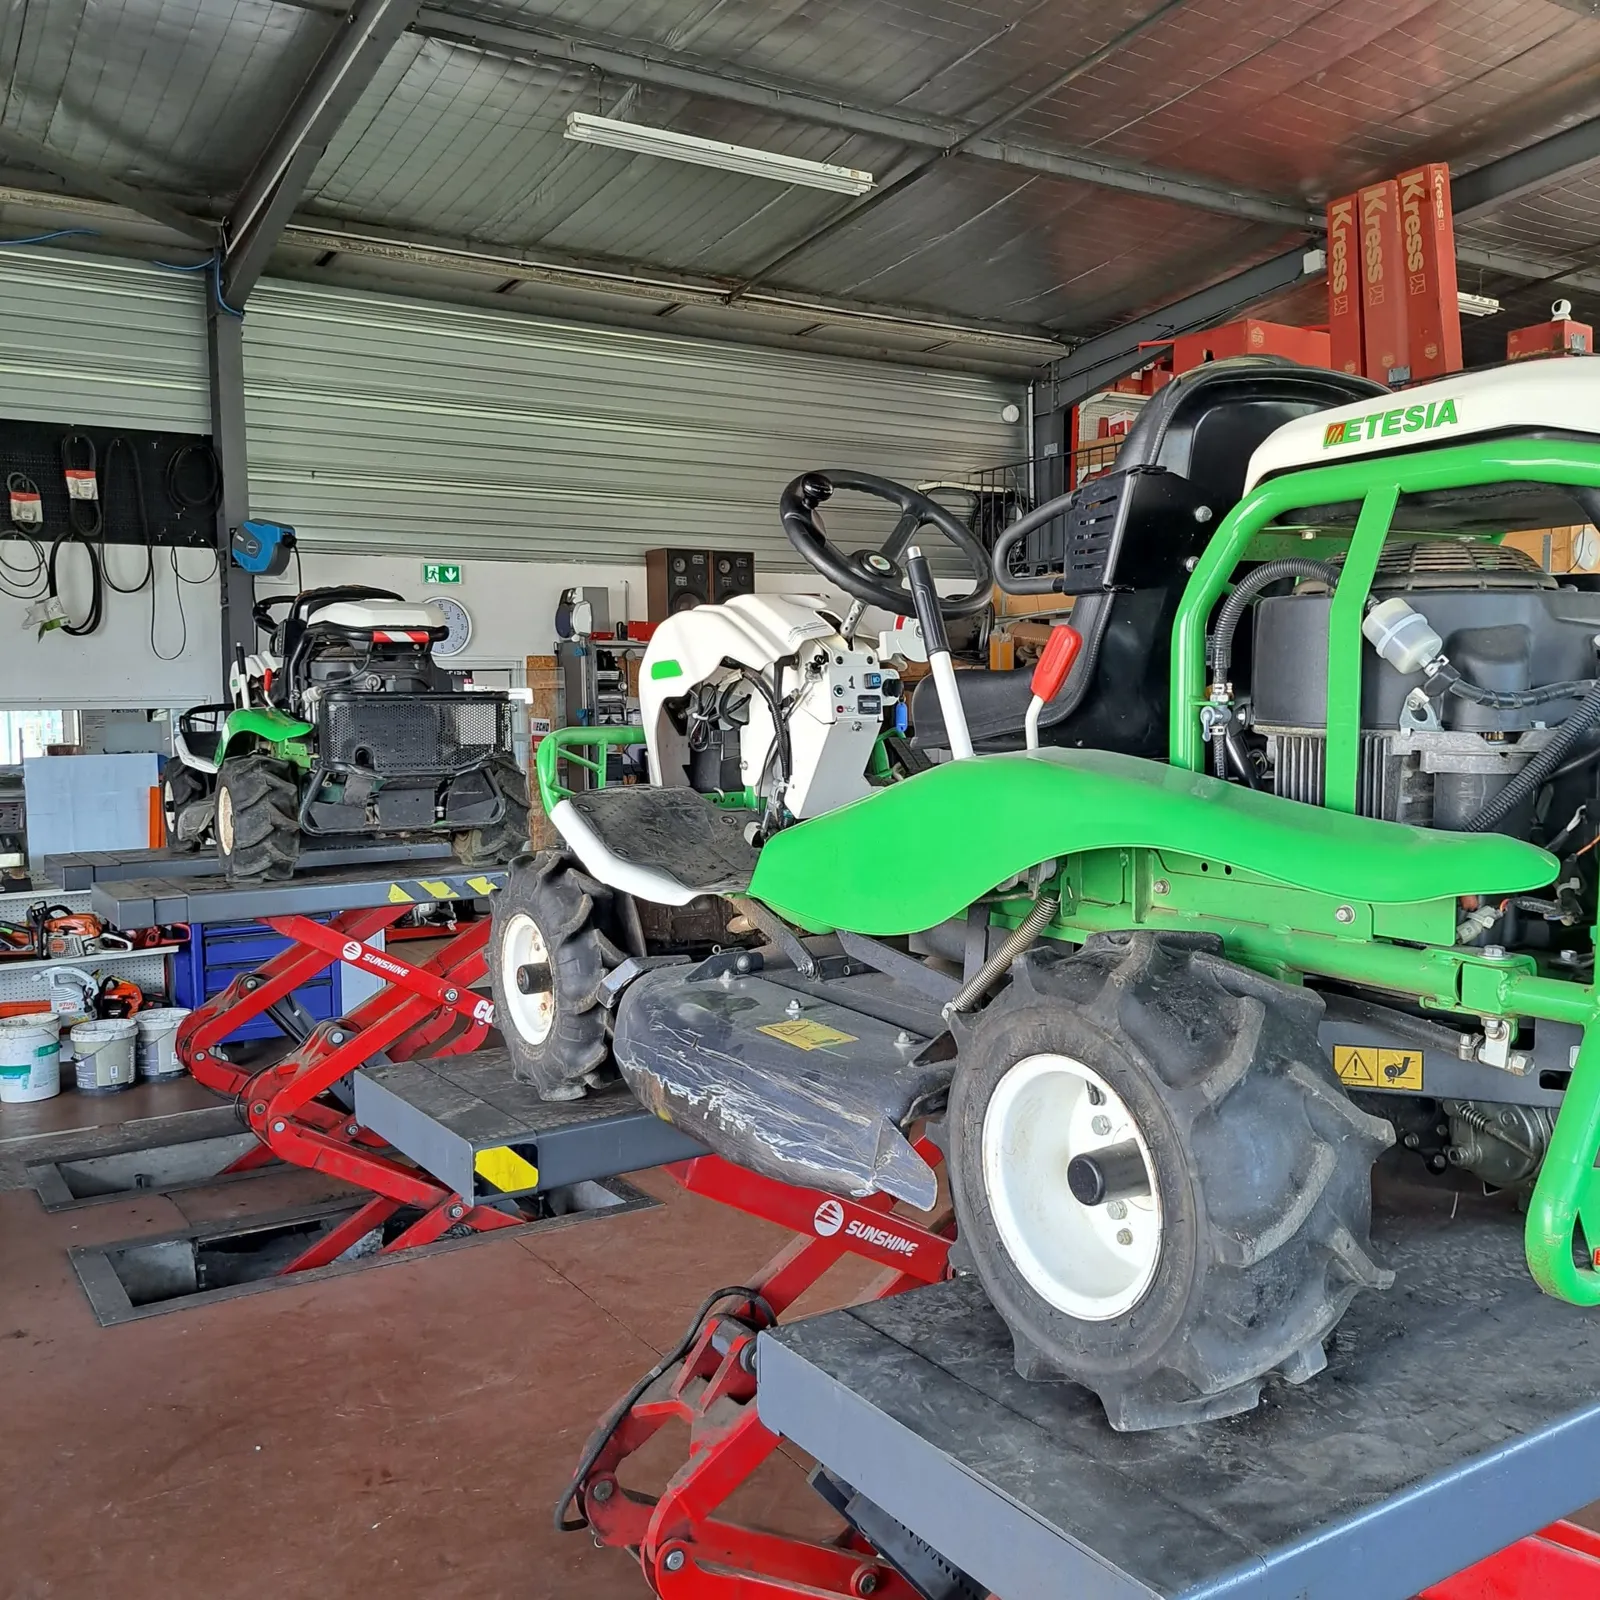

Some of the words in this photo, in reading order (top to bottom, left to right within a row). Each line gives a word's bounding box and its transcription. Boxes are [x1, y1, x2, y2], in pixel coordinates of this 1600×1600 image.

[1434, 169, 1445, 219] Kress
[1363, 187, 1387, 284] Kress
[1401, 172, 1425, 272] Kress
[1332, 200, 1352, 295] Kress
[1341, 398, 1458, 443] ETESIA
[535, 721, 550, 733] ECHO
[362, 953, 410, 977] SUNSHINE
[845, 1219, 920, 1258] SUNSHINE
